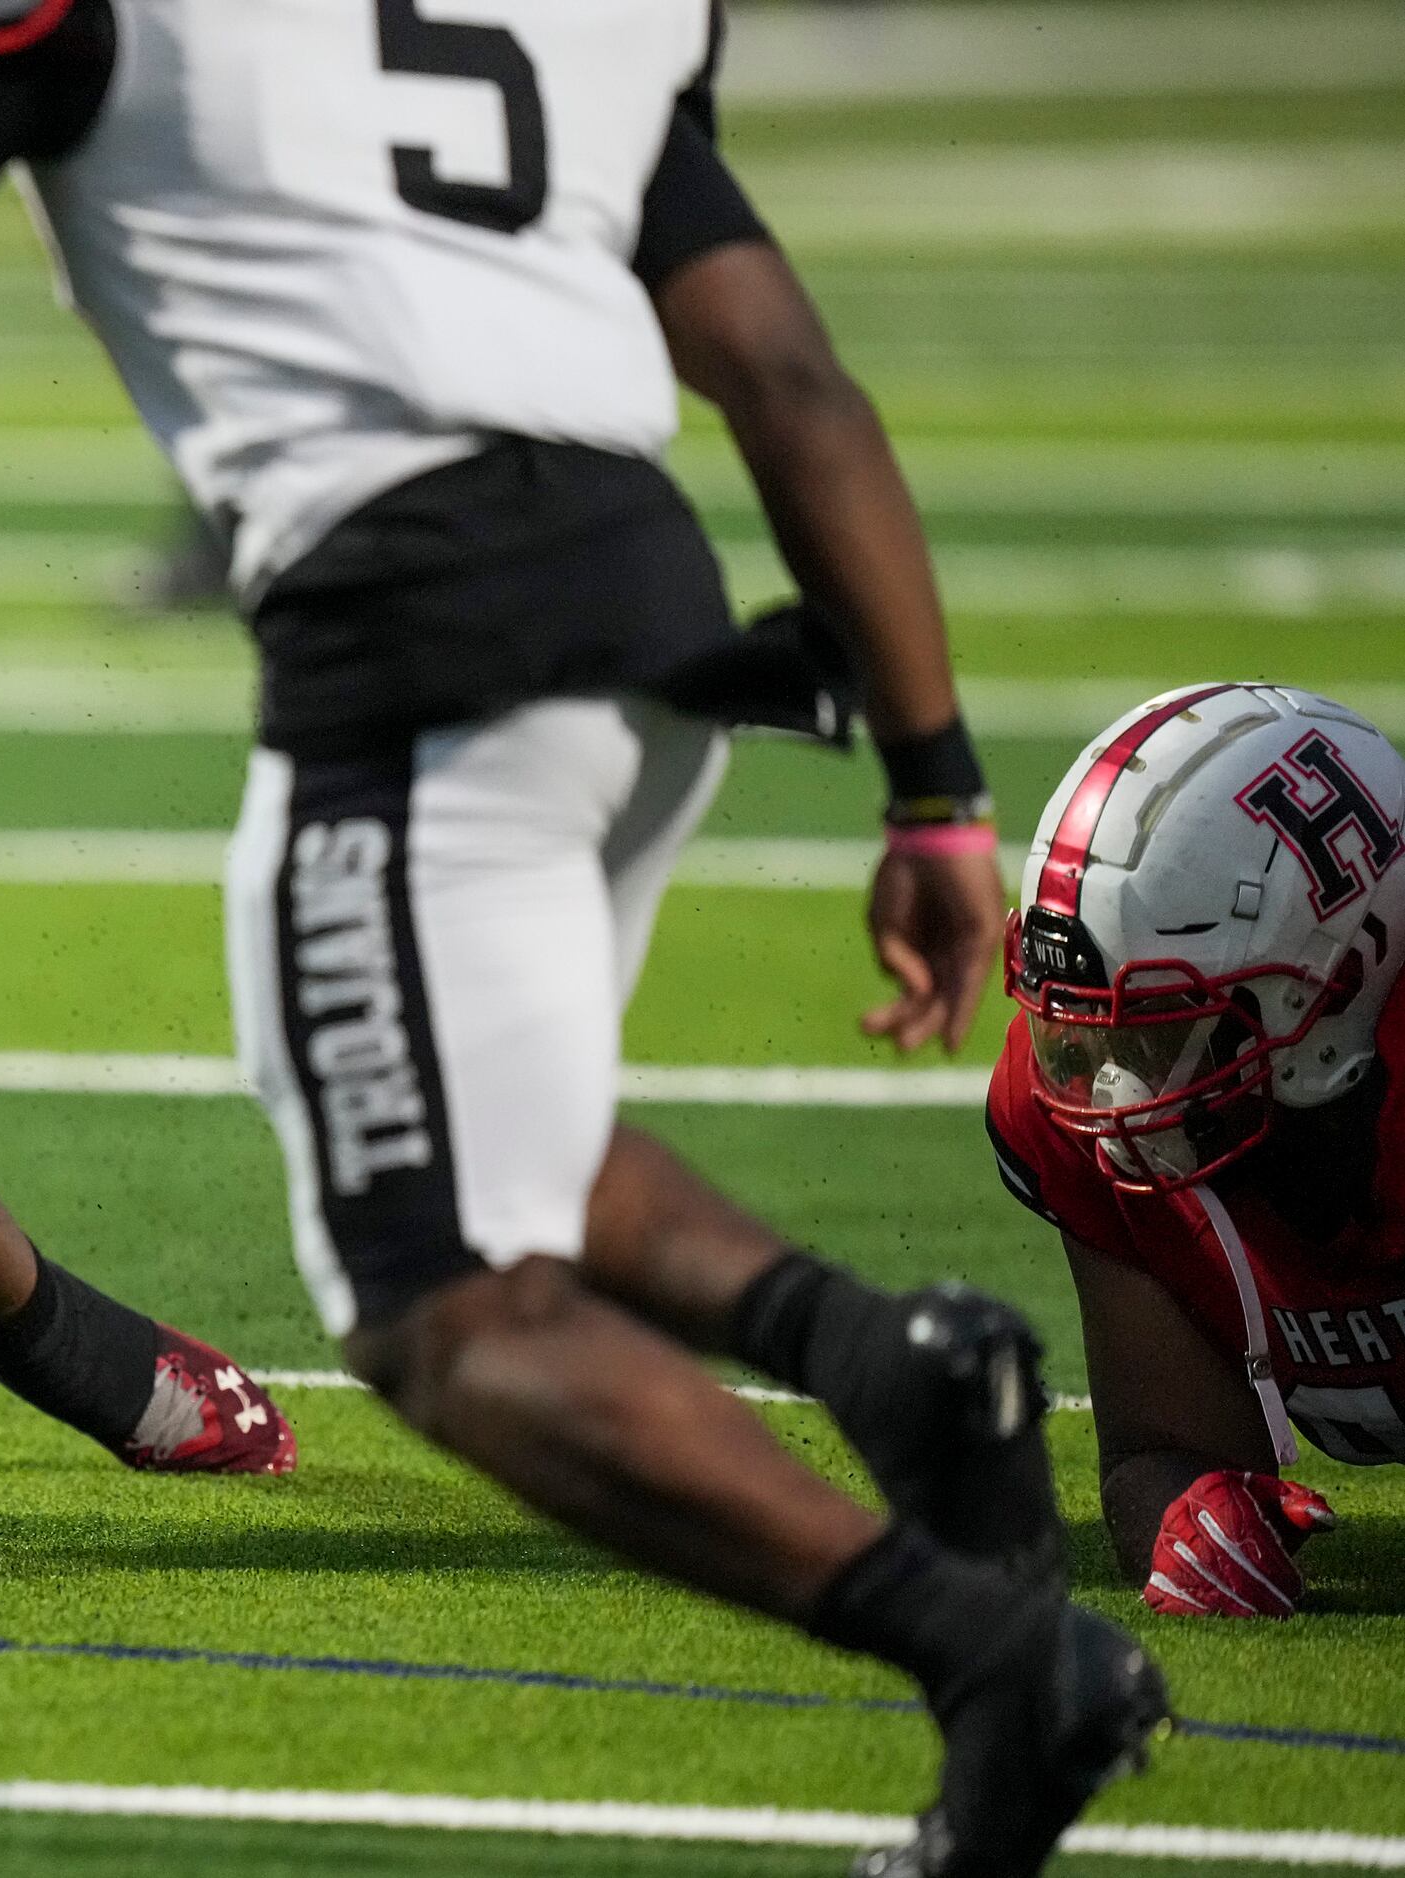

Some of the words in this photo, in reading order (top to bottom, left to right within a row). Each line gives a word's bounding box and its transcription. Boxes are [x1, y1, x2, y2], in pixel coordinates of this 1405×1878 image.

[377, 0, 548, 235] 5
[1233, 728, 1405, 923] H
[292, 816, 434, 1196] TROJANS
[1034, 939, 1067, 969] WTD
